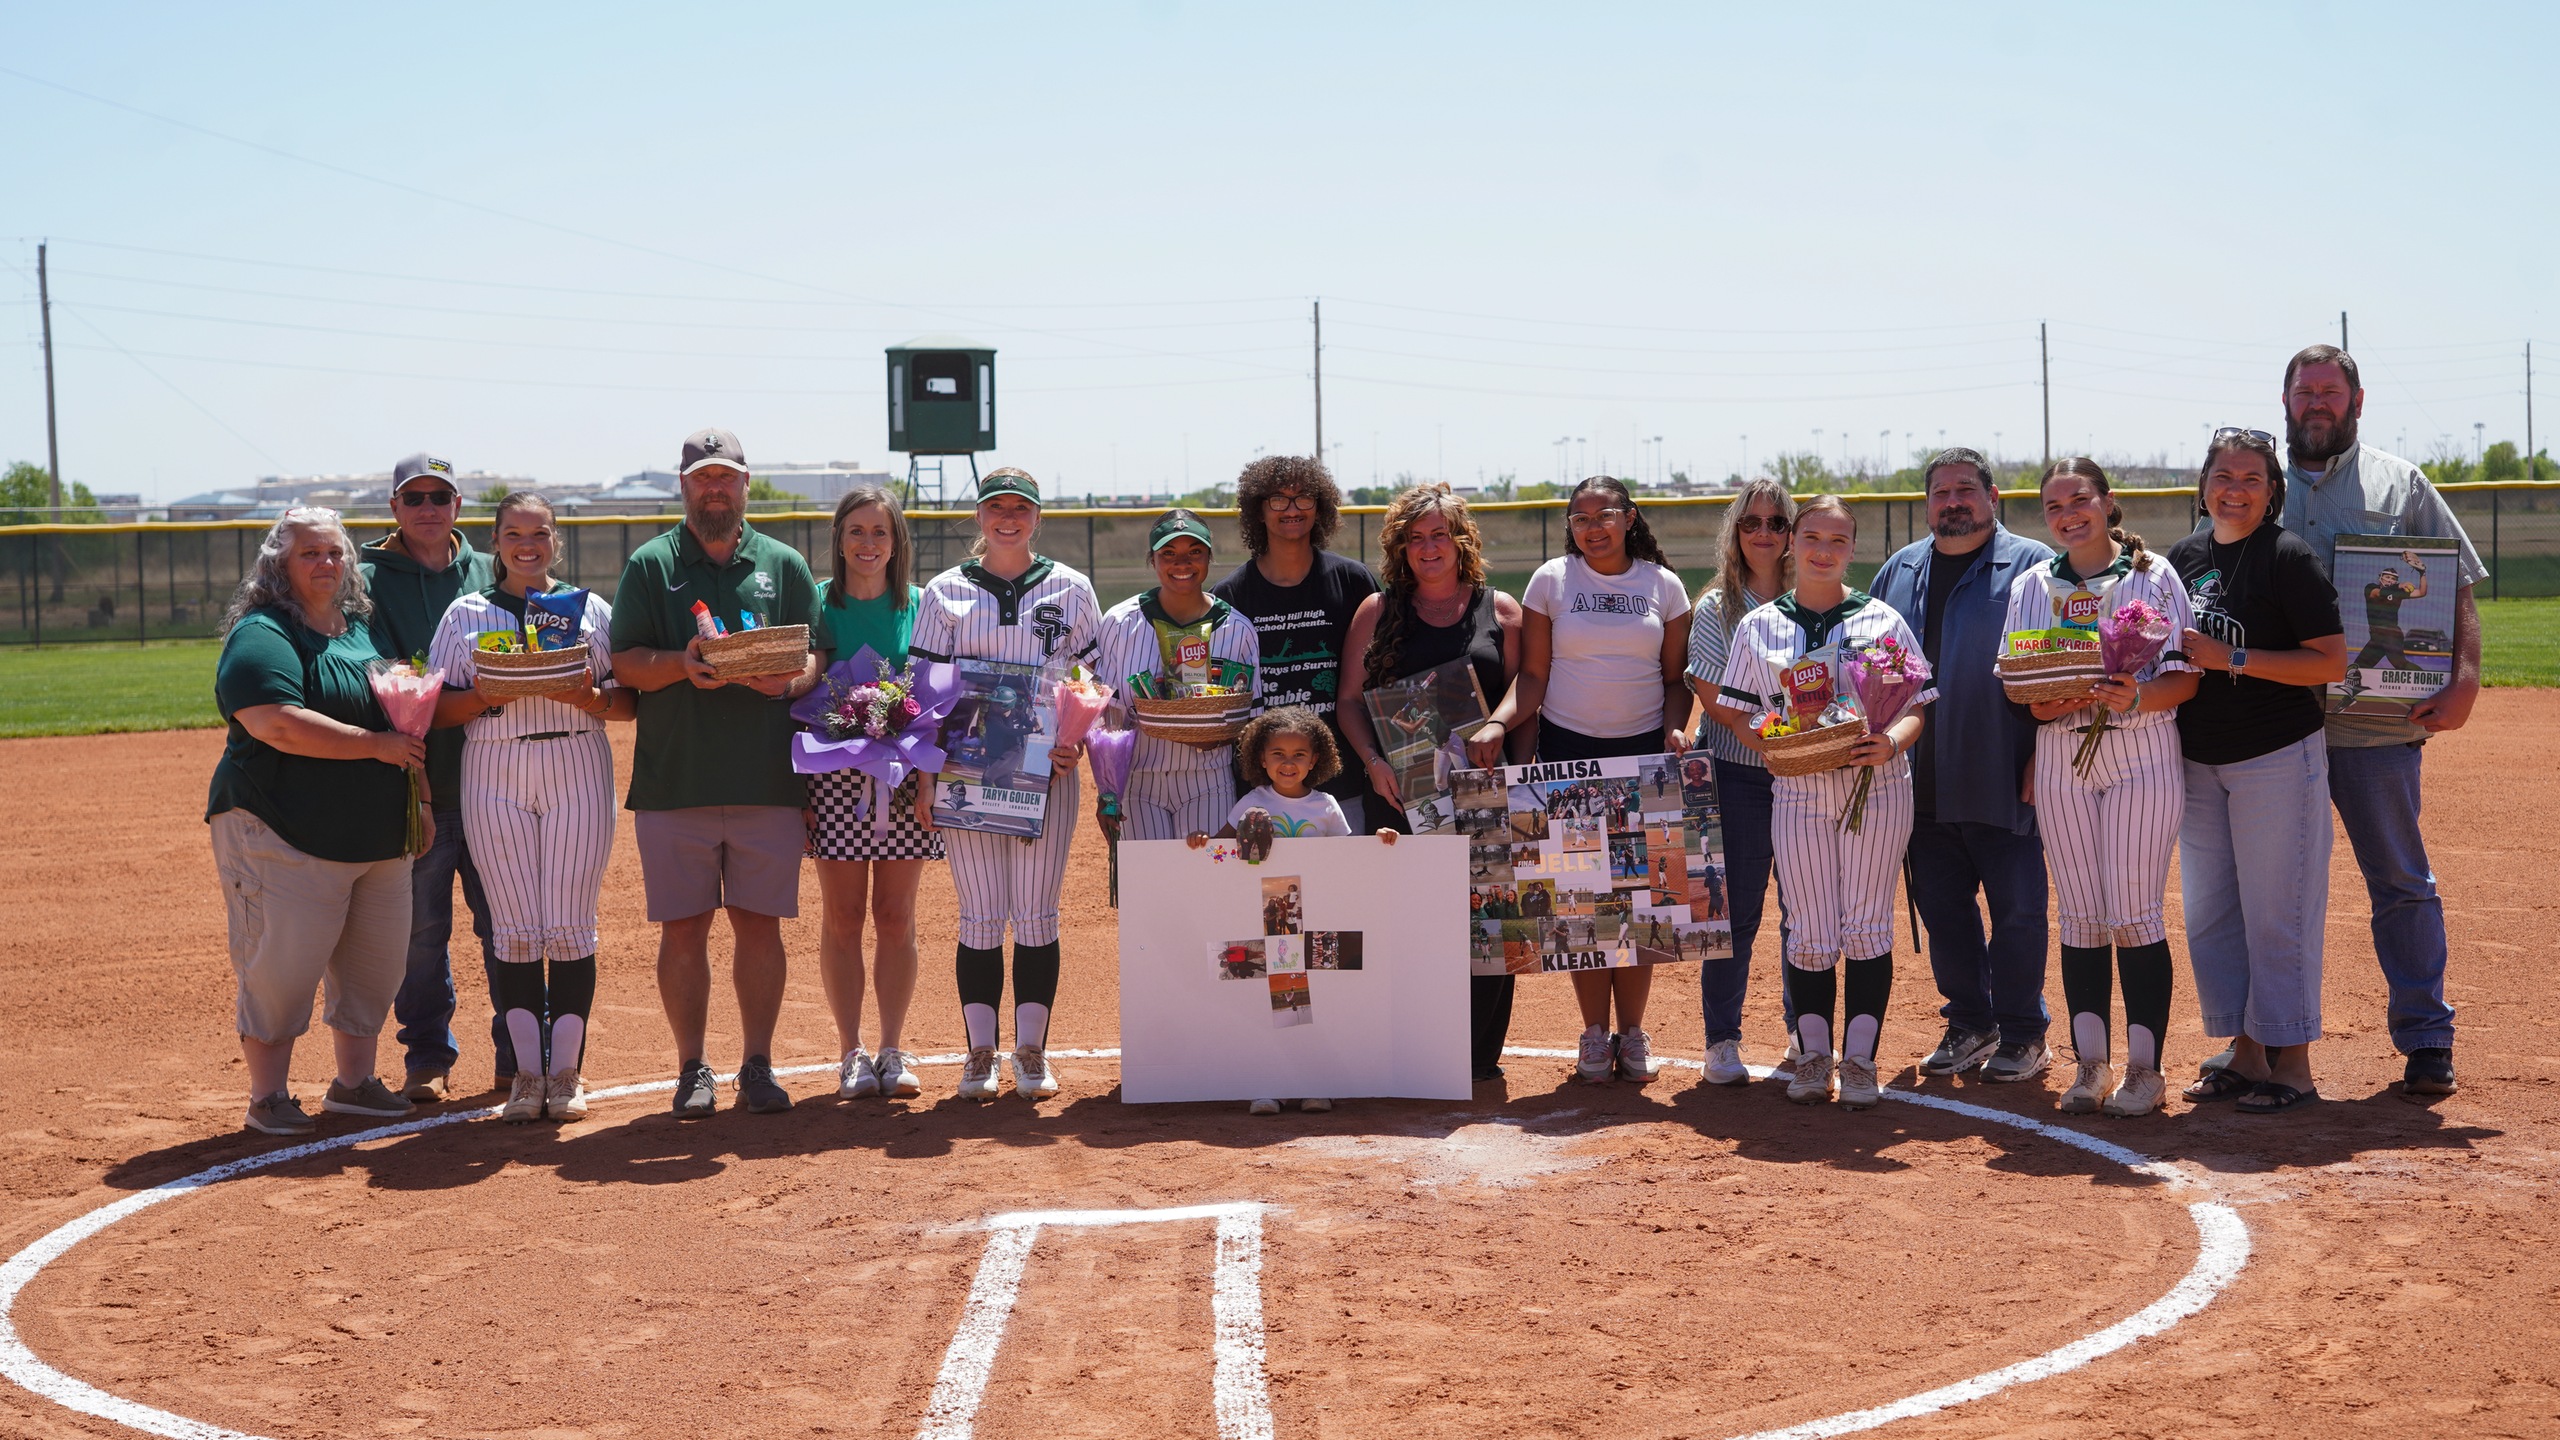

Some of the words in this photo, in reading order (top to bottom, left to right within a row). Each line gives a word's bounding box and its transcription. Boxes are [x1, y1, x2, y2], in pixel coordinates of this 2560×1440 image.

[1571, 592, 1650, 617] AERO
[2068, 597, 2100, 617] Lay's
[525, 608, 570, 631] oritos
[1253, 613, 1286, 623] Smoky
[1287, 611, 1302, 620] Hill
[1303, 609, 1325, 619] High
[1254, 622, 1286, 632] School
[1181, 642, 1207, 662] Lay's
[2015, 639, 2052, 651] HARIB
[1260, 665, 1289, 676] Ways
[1290, 663, 1302, 672] to
[1793, 664, 1824, 687] Lay's
[2381, 670, 2412, 684] GRACE
[2413, 672, 2444, 686] HORNE
[1261, 680, 1278, 692] he
[1263, 688, 1312, 707] ombie
[1796, 690, 1827, 705] KETTLE
[1517, 760, 1602, 784] JAHLISA
[982, 787, 1008, 802] TARYN
[1009, 791, 1041, 806] GOLDEN
[1517, 859, 1535, 867] FINAL
[1534, 852, 1603, 874] JELLY
[1541, 950, 1607, 972] KLEAR
[1615, 948, 1631, 968] 2
